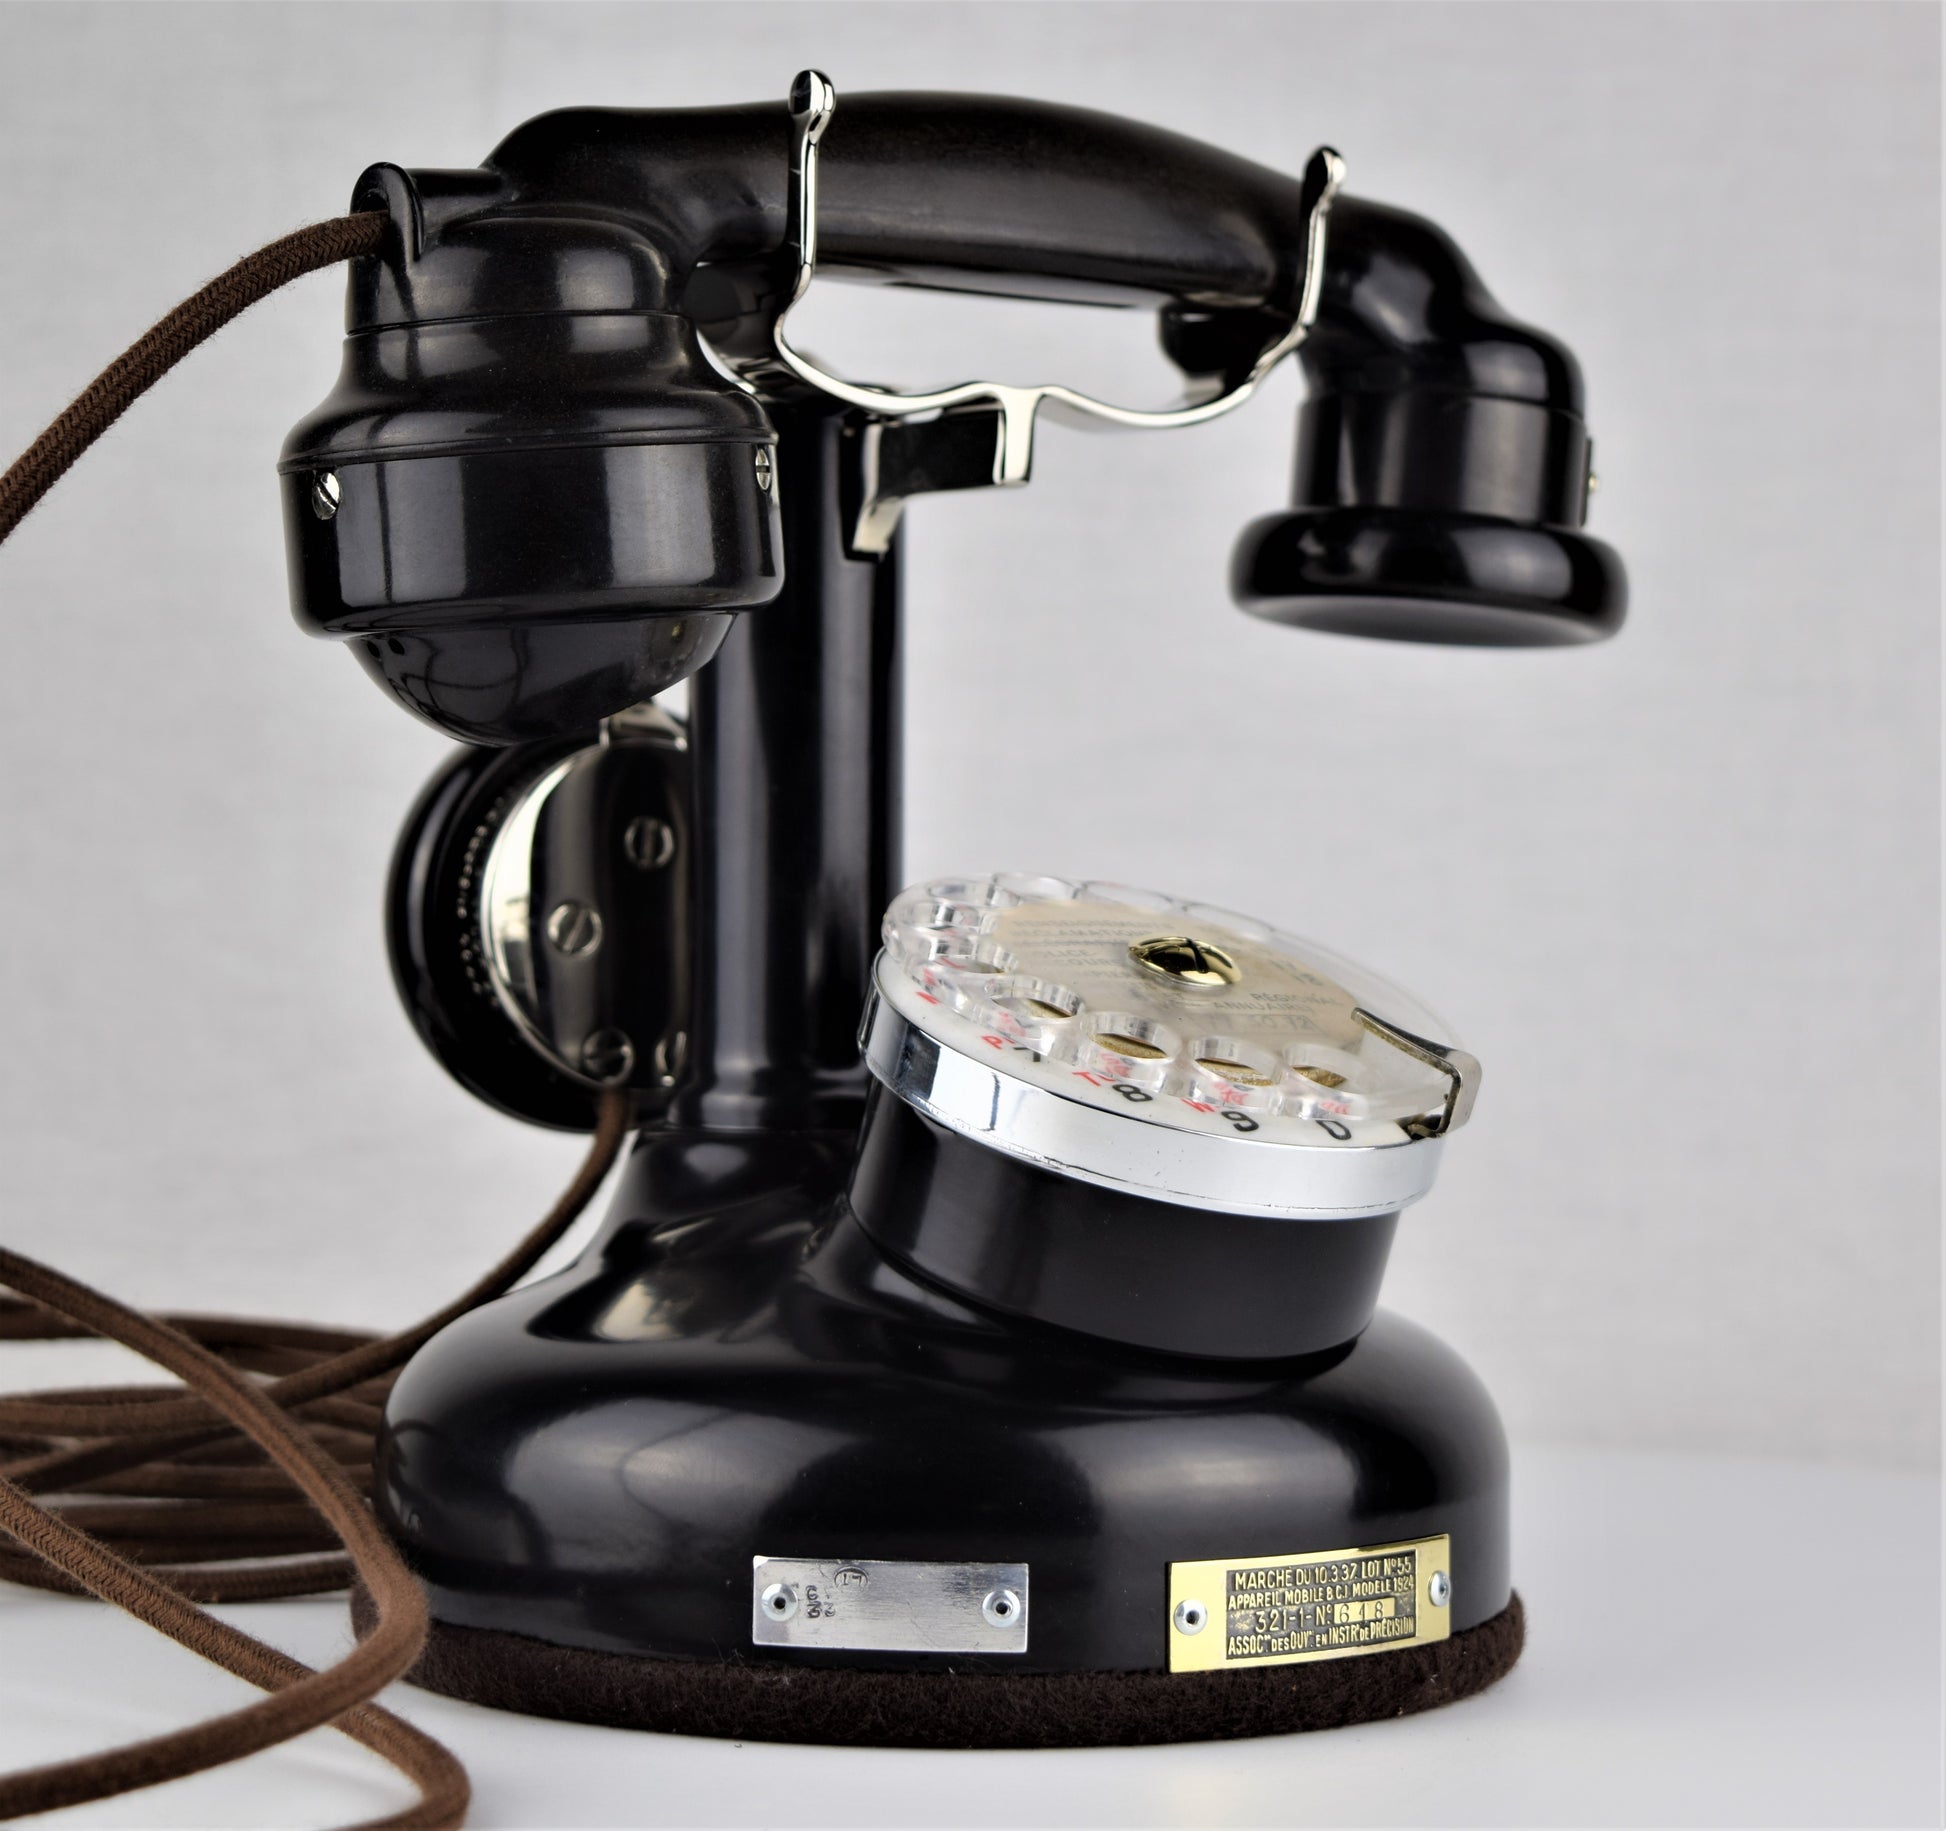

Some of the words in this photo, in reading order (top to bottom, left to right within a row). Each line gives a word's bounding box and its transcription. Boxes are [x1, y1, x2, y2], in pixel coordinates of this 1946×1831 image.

[1111, 1084, 1153, 1102] 8
[1221, 1110, 1260, 1132] 9
[1296, 1568, 1311, 1585] DU
[1361, 1559, 1381, 1579] LOT
[1228, 1591, 1281, 1610] APPAREIL
[1284, 1587, 1323, 1605] MOBILE
[1393, 1574, 1414, 1592] 1924
[1271, 1637, 1290, 1652] DES
[1315, 1633, 1328, 1648] EN
[1360, 1627, 1369, 1641] DE
